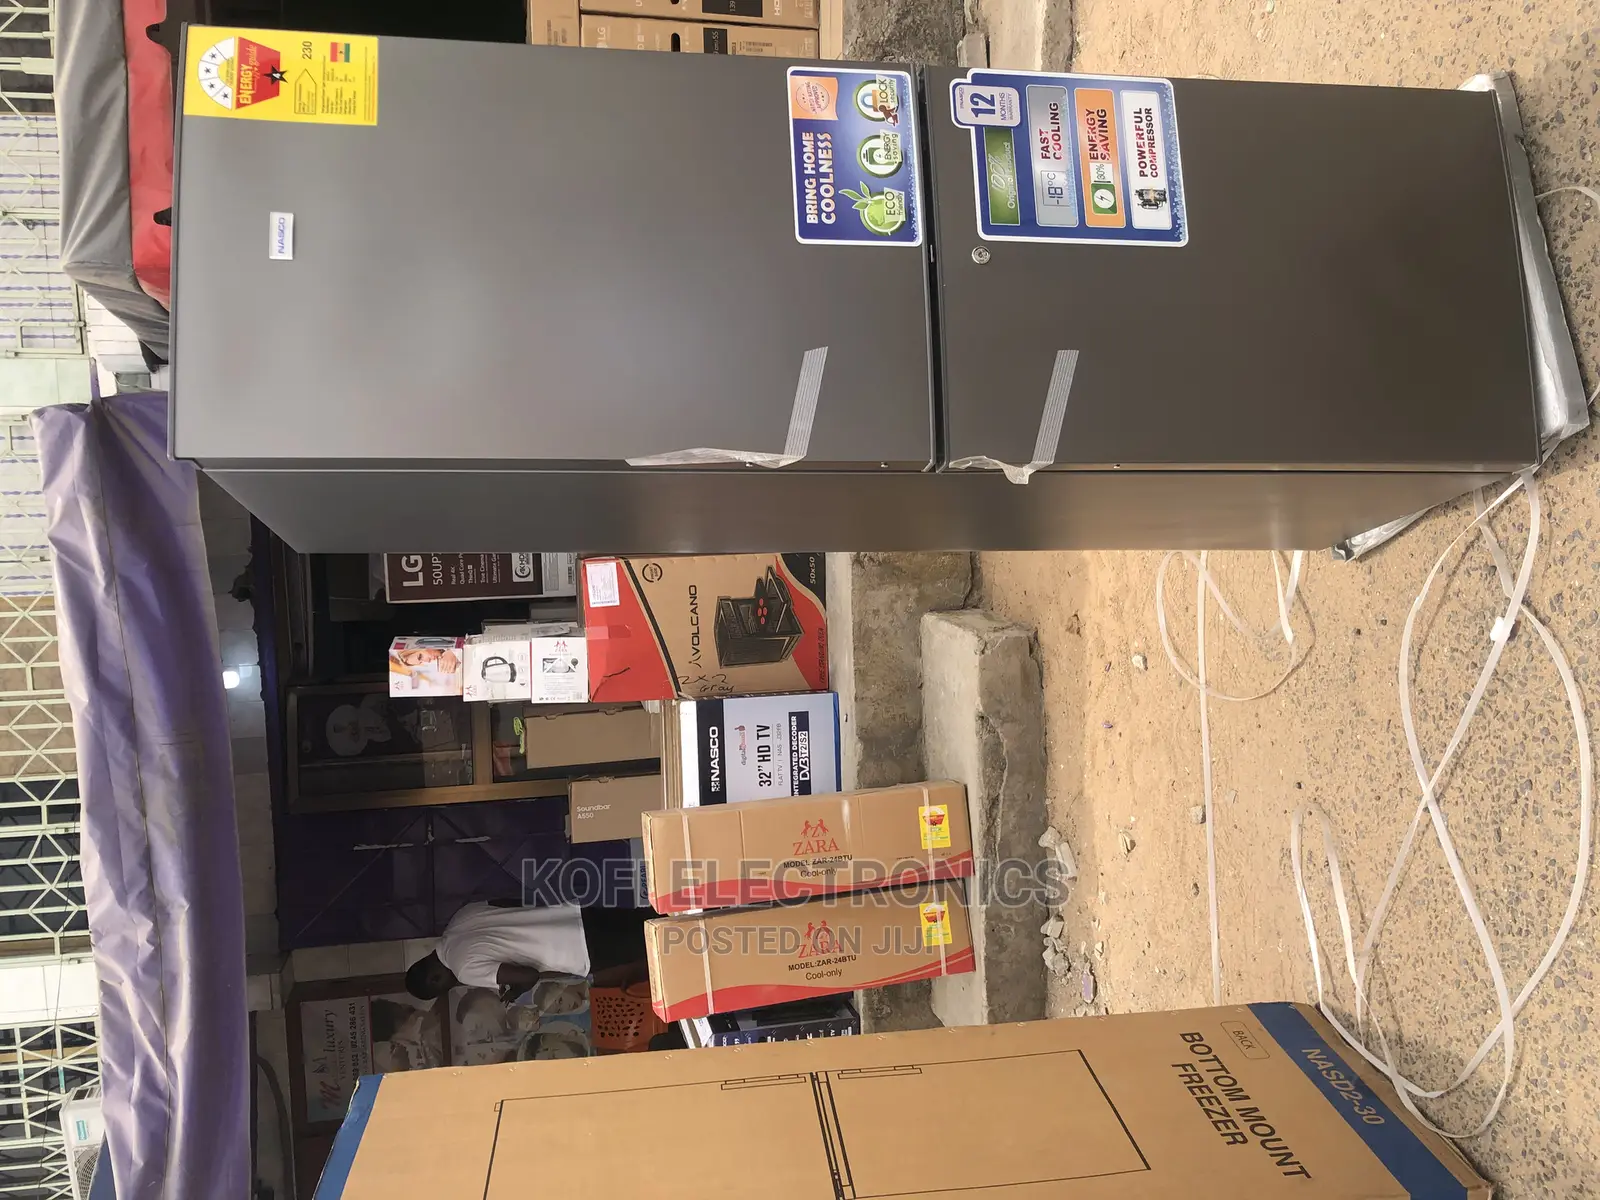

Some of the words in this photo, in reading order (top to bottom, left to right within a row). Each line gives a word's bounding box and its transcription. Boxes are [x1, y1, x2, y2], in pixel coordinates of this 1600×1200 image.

[597, 27, 606, 40] LG
[302, 41, 312, 60] 230
[236, 64, 256, 104] ENERGY
[877, 78, 889, 103] LOCK
[886, 78, 896, 104] security
[969, 92, 996, 118] 12
[1038, 128, 1051, 160] FAST
[1049, 102, 1063, 160] COOLING
[1085, 108, 1099, 160] ENERGY
[1096, 108, 1110, 161] SAVING
[1133, 107, 1148, 178] POWERFUL
[1144, 107, 1159, 178] COMPRESSOR
[802, 132, 816, 174] HOME
[882, 132, 892, 160] ENERGY
[890, 134, 900, 160] saving
[1002, 142, 1014, 174] Product
[816, 132, 836, 224] COOLNESS
[988, 152, 1006, 191] 100%
[804, 178, 818, 224] BRING
[884, 191, 896, 216] ECO
[896, 192, 904, 216] friendly
[1003, 174, 1017, 209] Original
[401, 554, 424, 587] LG
[688, 584, 700, 656] VOLCANO
[756, 724, 771, 740] TV
[800, 732, 808, 756] T2/S2
[710, 726, 720, 781] NASCO
[756, 744, 771, 763] HD
[778, 764, 783, 772] TV
[576, 804, 612, 812] Soundbar
[792, 837, 840, 857] ZARA
[800, 867, 838, 878] Cool-only
[798, 938, 844, 959] ZARA
[787, 954, 858, 972] MODEL:ZAR-24BTU
[805, 967, 843, 981] Cool-only
[348, 1002, 356, 1016] 431
[322, 1009, 337, 1053] luxury
[1232, 1030, 1256, 1050] BACK
[1300, 1048, 1386, 1126] NASD2-30
[1171, 1063, 1248, 1146] FREEZER
[1179, 1032, 1251, 1102] BOTTOM
[1236, 1106, 1312, 1180] MOUNT
